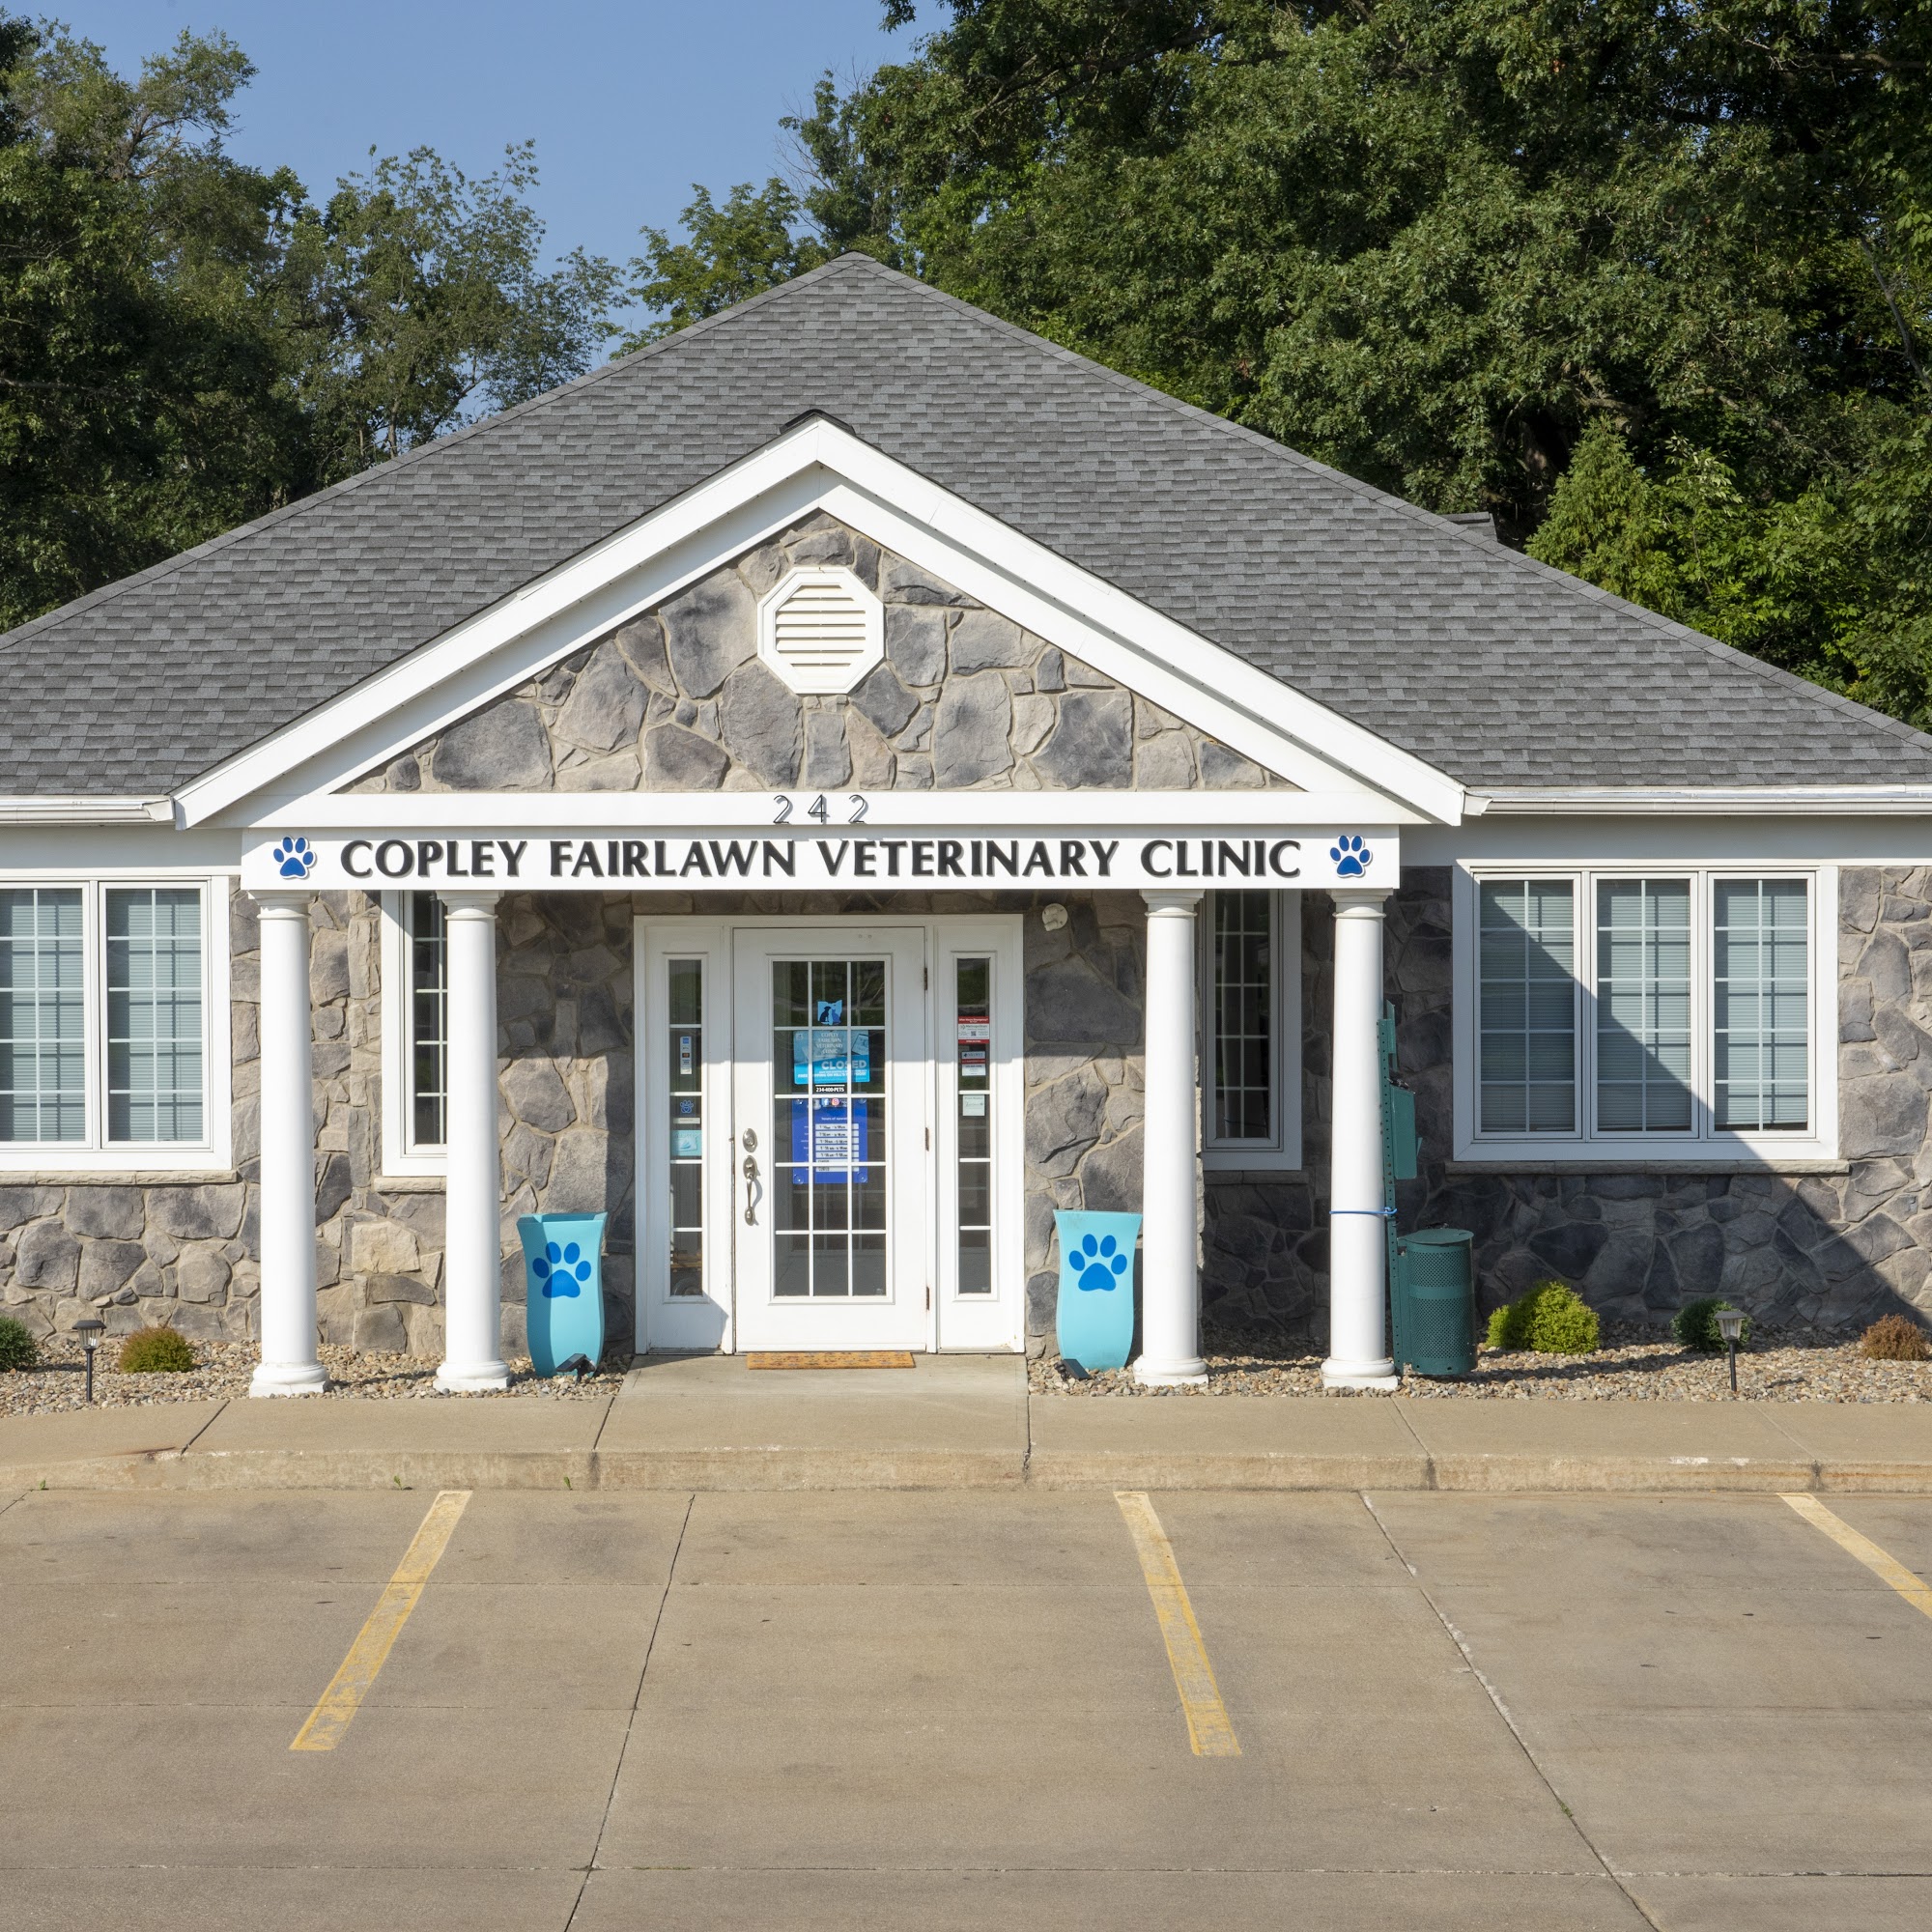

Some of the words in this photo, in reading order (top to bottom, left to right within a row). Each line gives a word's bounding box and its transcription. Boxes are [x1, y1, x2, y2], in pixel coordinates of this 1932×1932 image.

[773, 794, 867, 824] 242
[341, 839, 526, 877] COPLEY
[550, 840, 794, 876] FAIRLAWN
[815, 840, 1119, 876] VETERINARY
[1140, 839, 1301, 877] CLINIC
